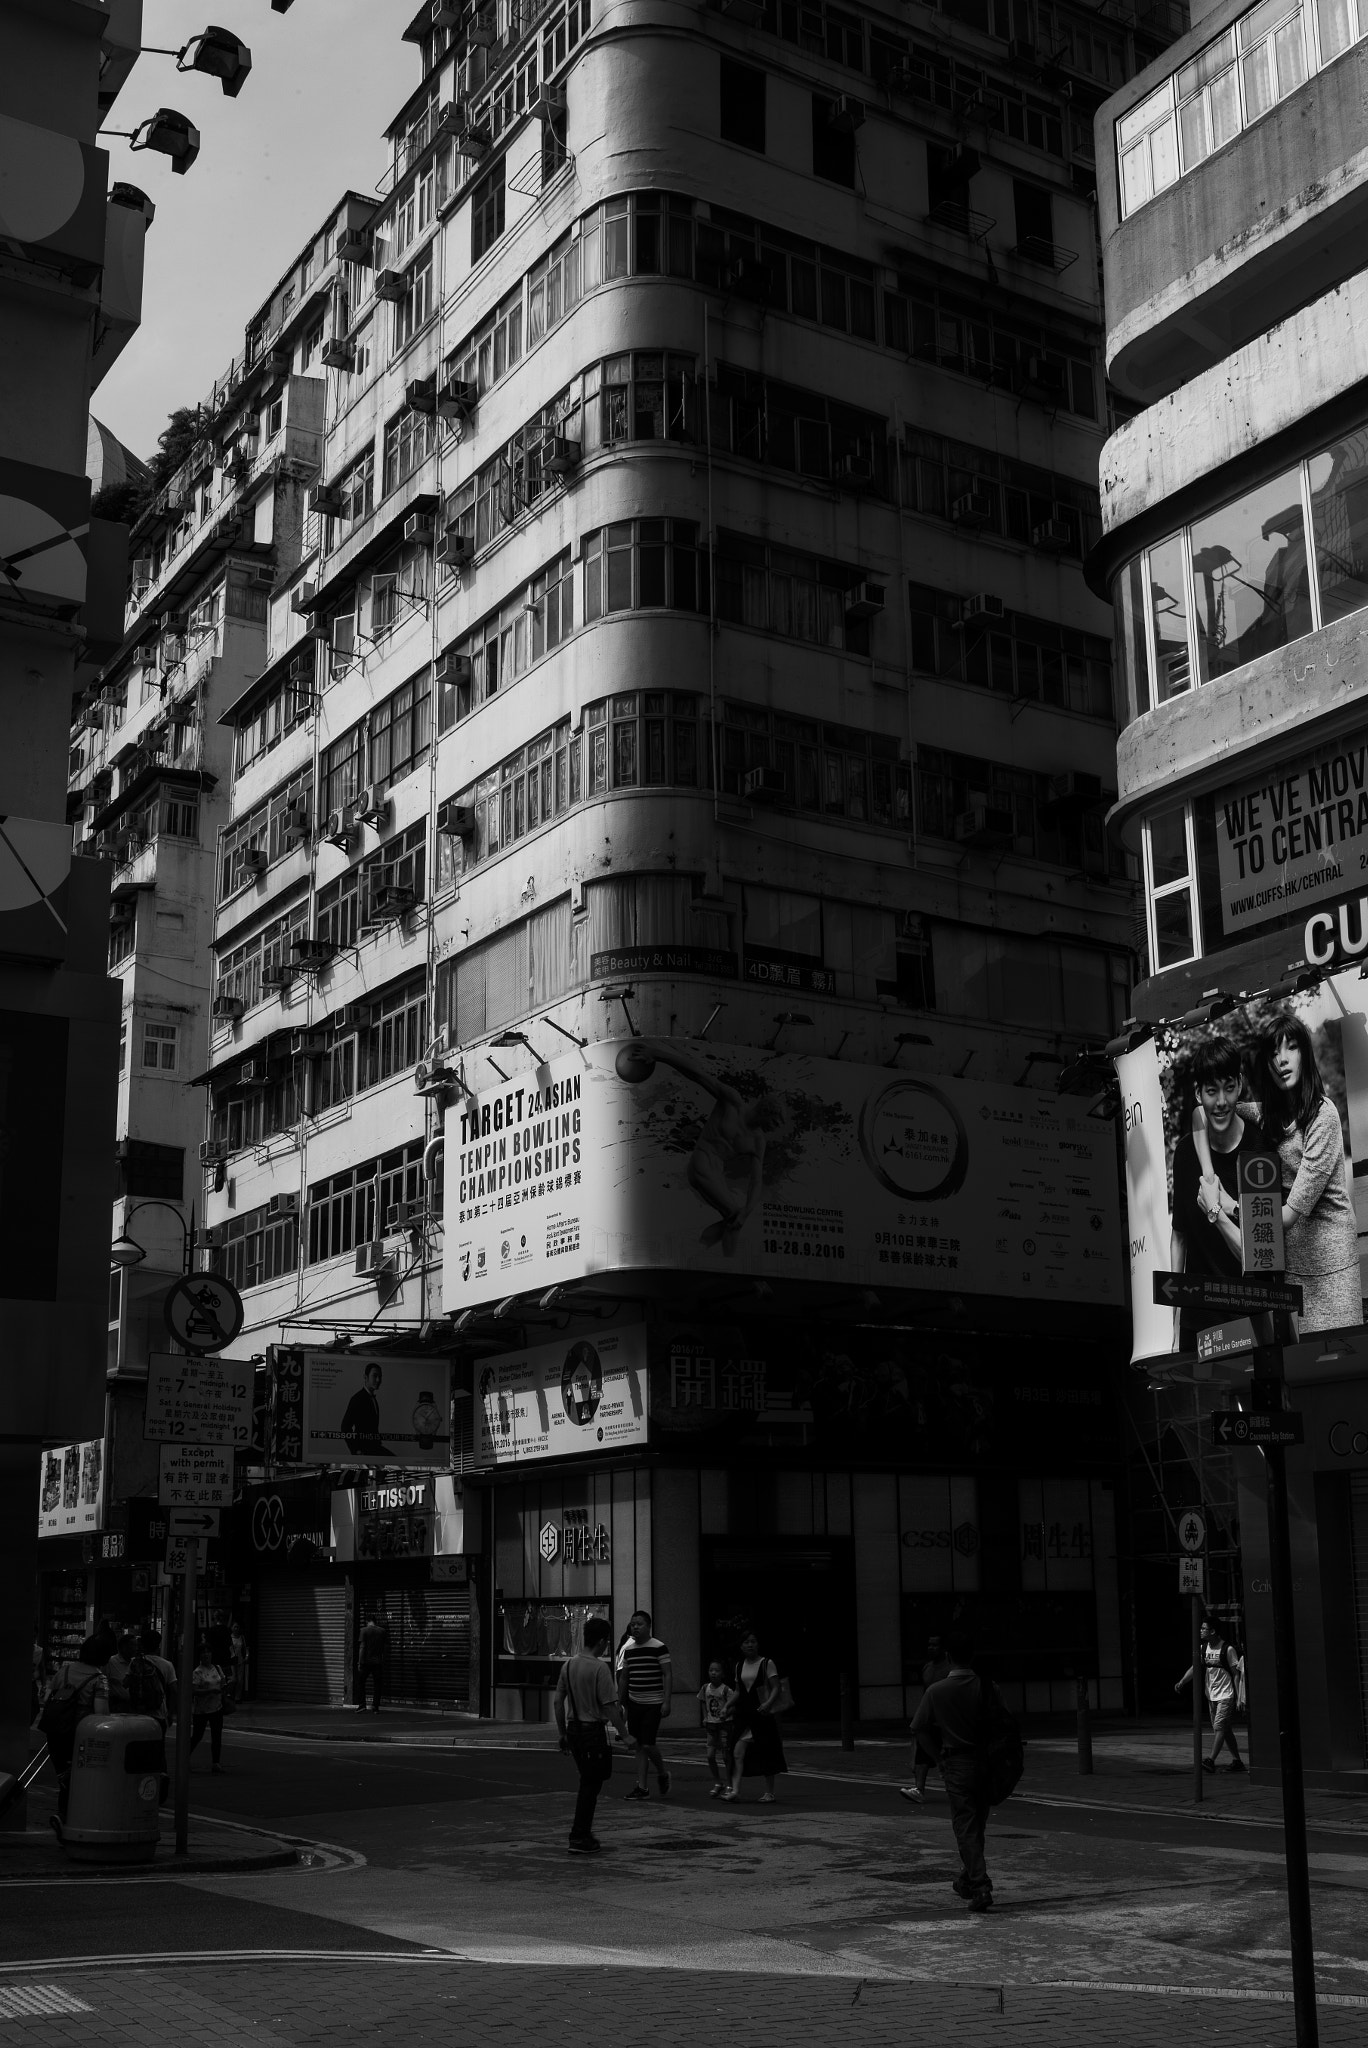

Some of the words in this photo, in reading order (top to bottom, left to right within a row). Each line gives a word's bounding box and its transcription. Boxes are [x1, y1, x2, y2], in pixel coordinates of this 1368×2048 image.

[1224, 774, 1302, 841] WE'VE
[1309, 744, 1368, 808] MOV
[1233, 834, 1265, 879] TO
[1230, 863, 1344, 916] WWW.CUFFS.HK/CENTRAL
[610, 954, 650, 970] Beauty
[652, 953, 664, 966] &
[667, 952, 691, 967] Nail
[460, 1088, 525, 1146] TARGET
[545, 1074, 581, 1111] ASIAN
[460, 1136, 506, 1176] TENPIN
[513, 1108, 581, 1156] BOWLING
[904, 1150, 950, 1163] 6161.com.hk
[460, 1138, 581, 1204] CHAMPIONSHIPS
[783, 1205, 815, 1215] BOWLING
[816, 1208, 844, 1217] CENTRE
[1250, 1195, 1276, 1269] 銅鑼灣
[763, 1239, 844, 1259] 18-28.9.2016
[878, 1249, 958, 1268] 慈善保齡球大賽
[1204, 1294, 1230, 1304] Causeway
[1231, 1297, 1241, 1306] Bay
[1241, 1298, 1263, 1308] Typhoon
[1213, 1344, 1222, 1353] The
[1222, 1342, 1231, 1351] Lee
[1231, 1337, 1252, 1350] Gardens
[187, 1359, 203, 1367] Mon.
[181, 1367, 224, 1380] 星期一至五
[175, 1379, 185, 1393] 7
[200, 1380, 229, 1389] midnight
[231, 1384, 246, 1398] 12
[205, 1389, 222, 1398] 午夜
[183, 1401, 211, 1410] General
[213, 1403, 242, 1412] Holidays
[165, 1408, 235, 1422] 星期六及公眾假期
[148, 1427, 166, 1436] 中午
[168, 1421, 185, 1435] 12
[200, 1422, 230, 1430] midnight
[232, 1426, 248, 1440] 12
[206, 1431, 224, 1440] 午夜
[327, 1432, 357, 1440] TISSOT
[359, 1432, 373, 1440] THIS
[382, 1433, 399, 1441] YOUR
[1249, 1432, 1271, 1441] Causeway
[1279, 1431, 1295, 1440] Station
[181, 1448, 214, 1458] Except
[170, 1459, 191, 1467] with
[193, 1459, 225, 1468] permit
[164, 1472, 230, 1484] 有許可證者
[170, 1489, 223, 1501] 不在此限
[377, 1484, 426, 1508] TISSOT
[149, 1521, 166, 1540] 時
[563, 1523, 607, 1564] 周生生
[902, 1530, 951, 1548] CSS
[1023, 1522, 1093, 1560] 周生生
[1185, 1562, 1198, 1571] End
[1251, 1579, 1273, 1593] Cal
